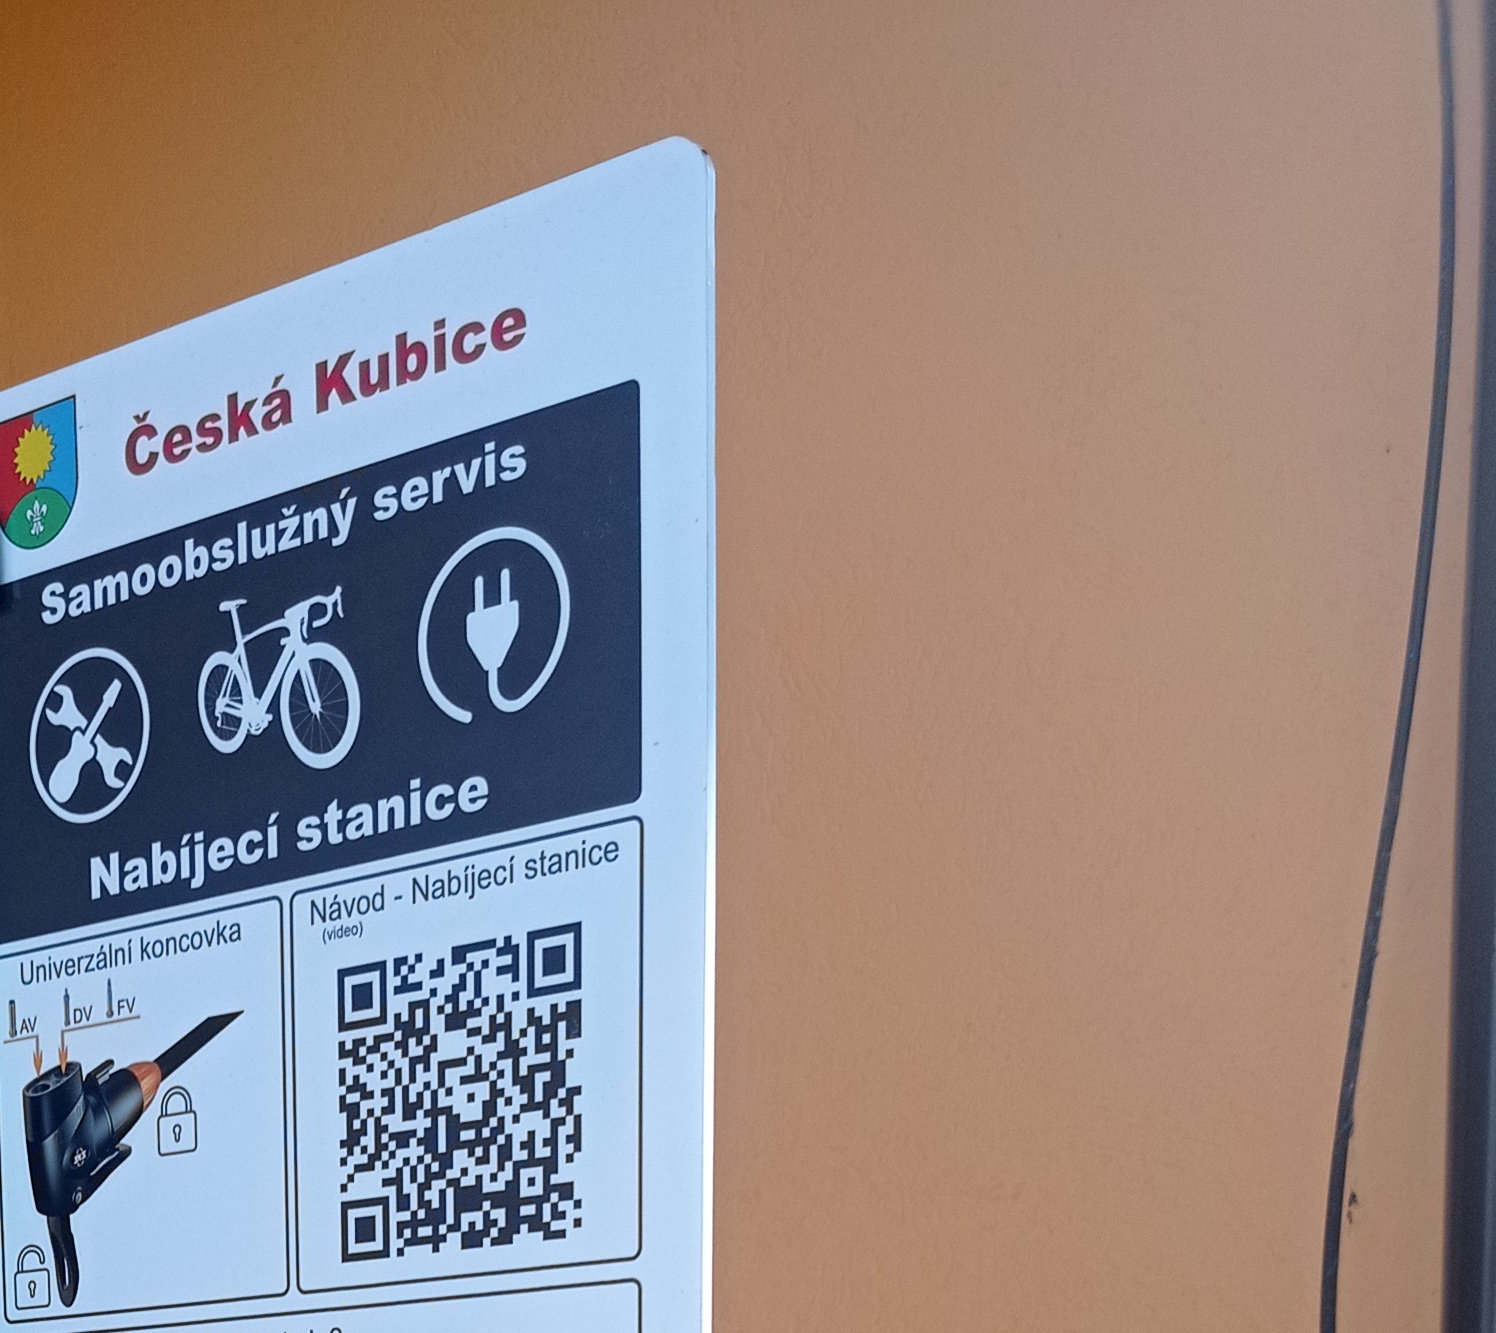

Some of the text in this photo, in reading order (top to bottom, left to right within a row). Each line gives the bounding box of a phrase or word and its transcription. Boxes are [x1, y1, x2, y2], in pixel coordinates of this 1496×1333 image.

[125, 308, 526, 475] Česká Kubice
[42, 441, 526, 624] Samoobslužný servis
[91, 776, 488, 900] Nabíjecí stanice
[311, 884, 384, 925] Návod
[413, 856, 514, 904] Nabíjecí
[525, 840, 619, 879] stanice
[21, 920, 241, 985] Univerzální koncovka
[323, 922, 363, 944] (video)
[20, 1017, 37, 1034] AV
[74, 1005, 92, 1024] DV
[118, 997, 135, 1015] FV
